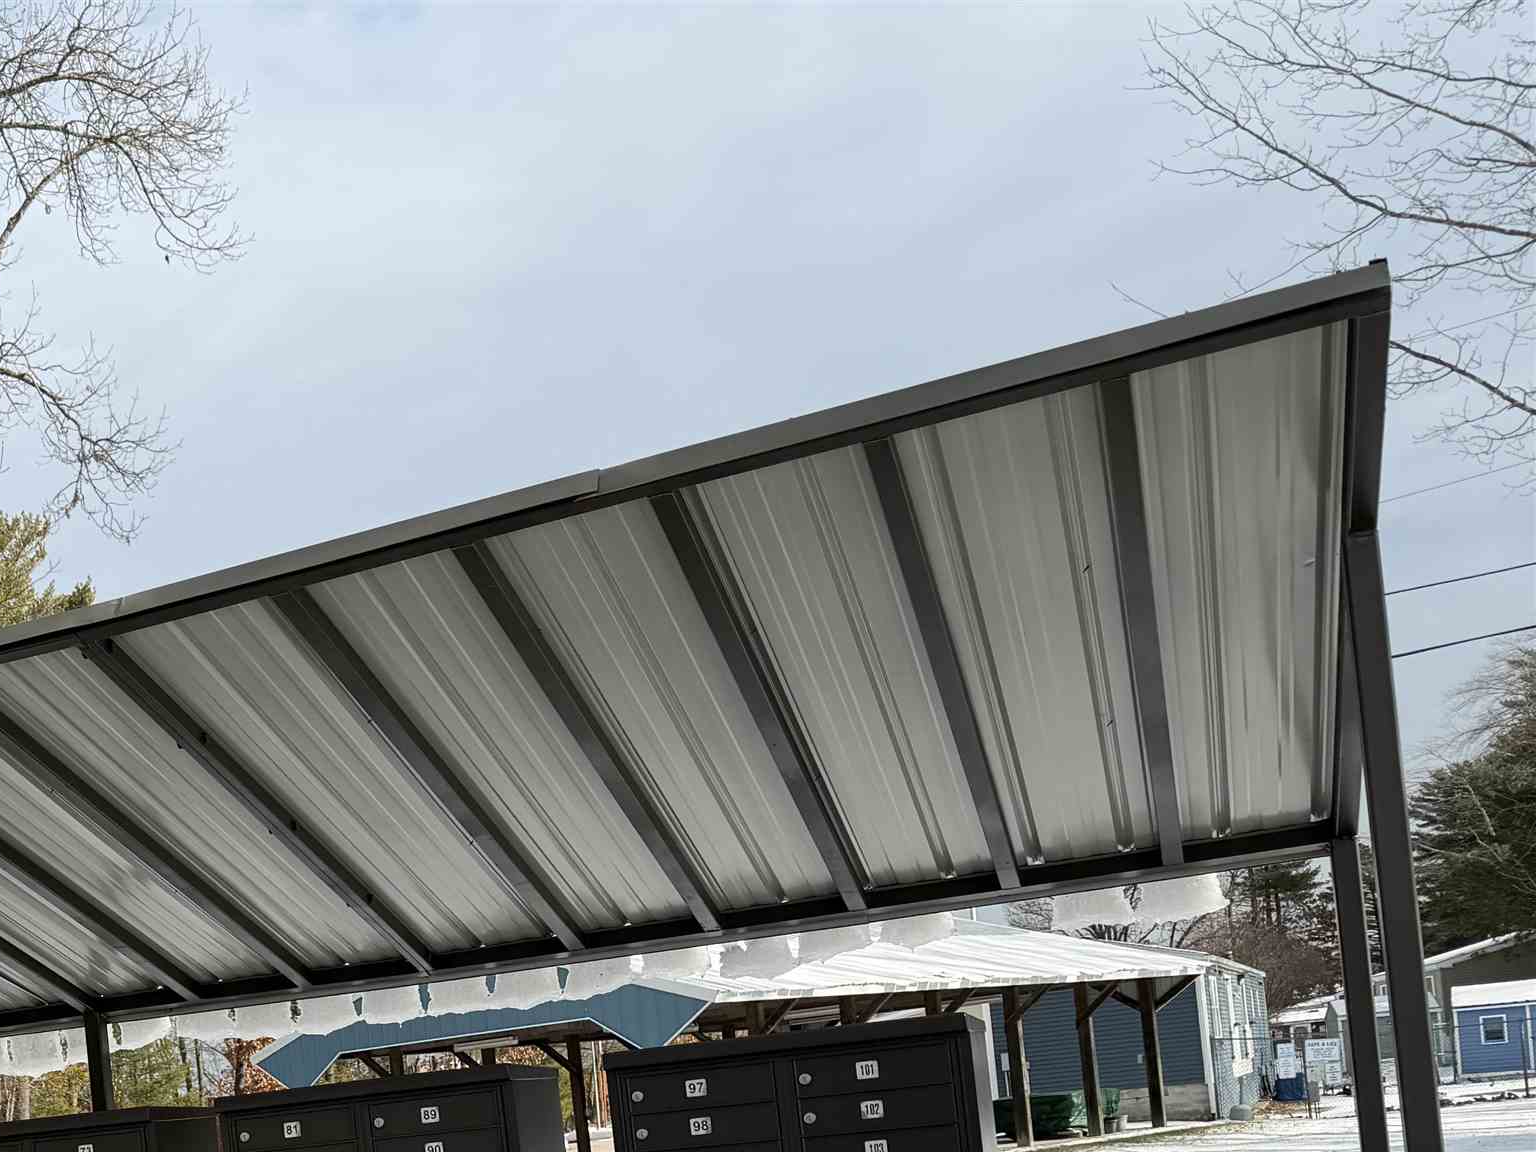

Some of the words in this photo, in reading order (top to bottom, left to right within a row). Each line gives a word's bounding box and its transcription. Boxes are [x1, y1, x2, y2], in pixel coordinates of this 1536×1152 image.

[860, 1063, 876, 1078] 101
[688, 1082, 704, 1094] 97
[423, 1109, 437, 1121] 89
[864, 1102, 880, 1116] 102
[286, 1124, 299, 1136] 81
[692, 1120, 710, 1132] 98
